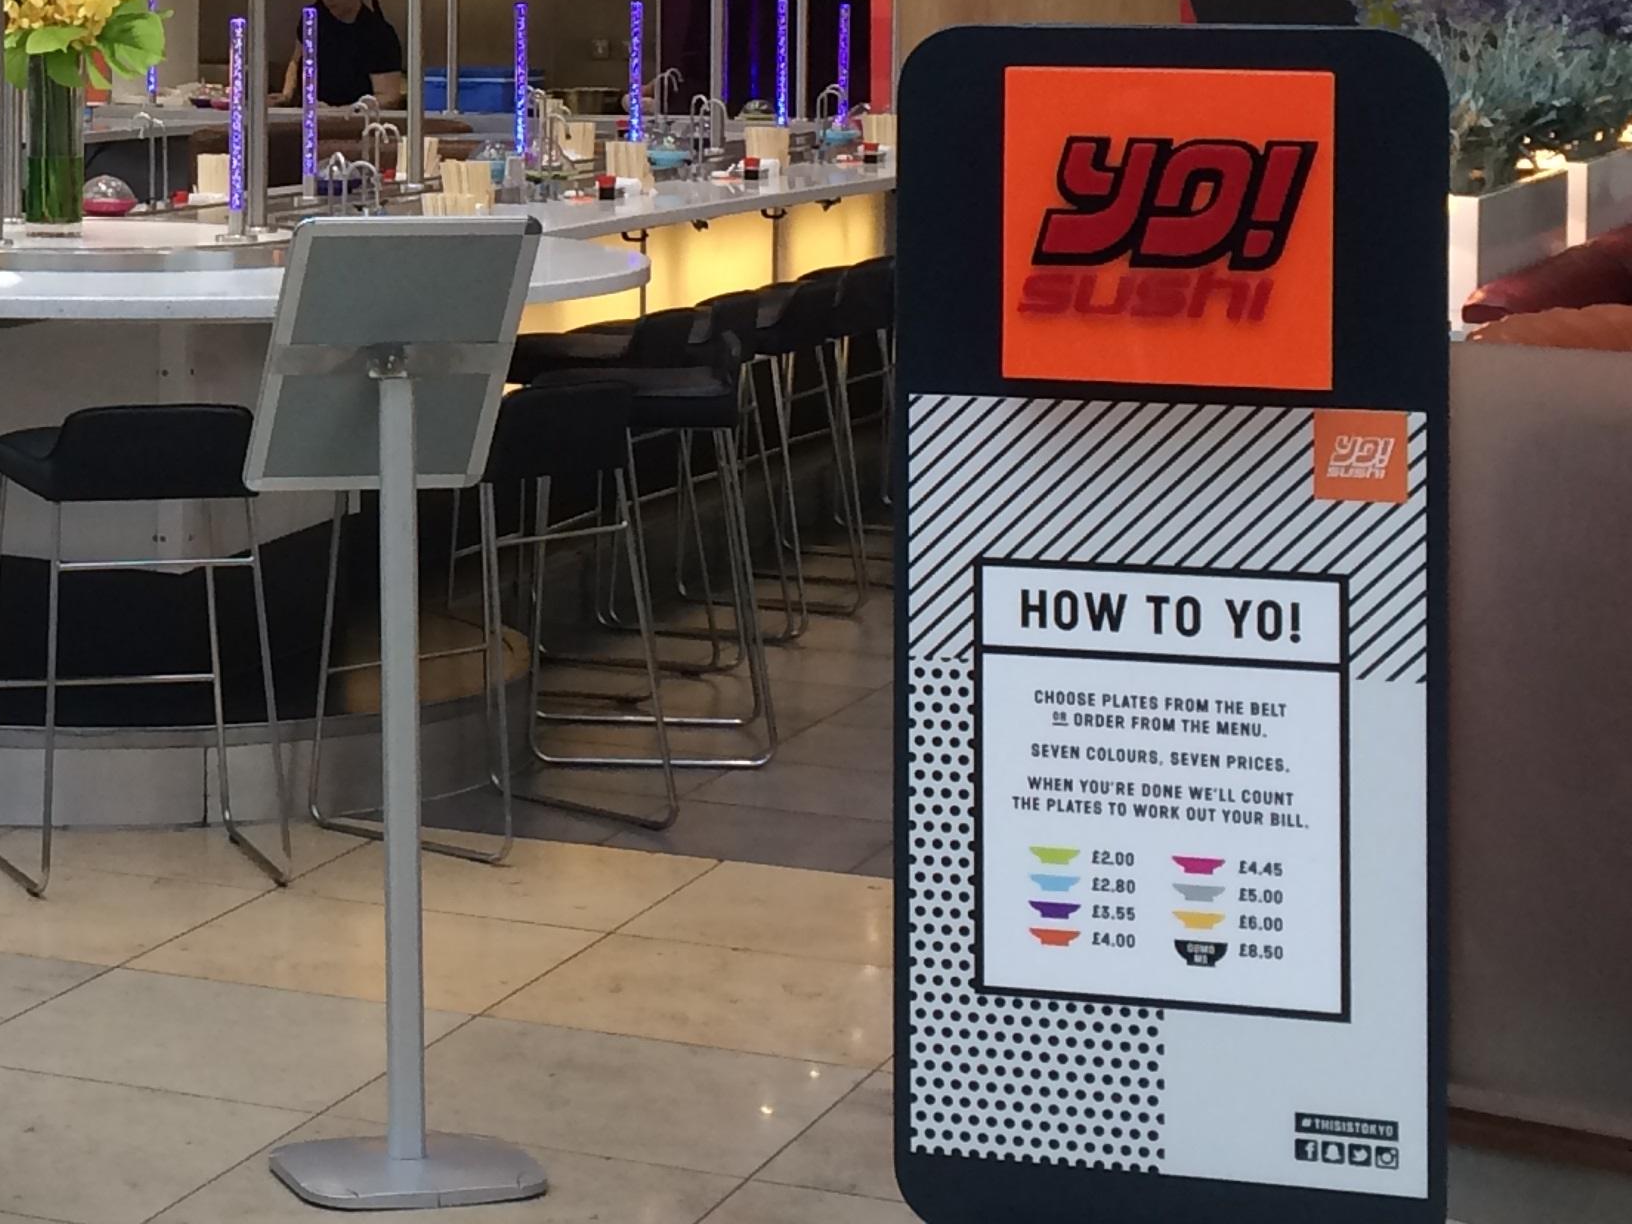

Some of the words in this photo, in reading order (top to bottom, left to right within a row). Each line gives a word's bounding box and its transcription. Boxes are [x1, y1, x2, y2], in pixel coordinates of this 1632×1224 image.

[1032, 135, 1319, 272] YO!
[1017, 267, 1275, 324] sushi
[1329, 435, 1395, 468] YO!
[1019, 589, 1128, 633] HOW
[1145, 595, 1202, 638] TO
[1225, 599, 1302, 644] YO!
[1034, 689, 1096, 707] CHOOSE
[1102, 693, 1159, 710] PLATES
[1165, 697, 1209, 713] FROM
[1215, 699, 1243, 715] THE
[1250, 701, 1287, 717] BELT
[1052, 711, 1069, 726] OR
[1074, 712, 1126, 729] ORDER
[1131, 716, 1176, 732] FROM
[1181, 719, 1209, 735] THE
[1216, 721, 1269, 738] MENU.
[1031, 743, 1080, 759] SEVEN
[1086, 746, 1164, 766] COLOURS,
[1170, 751, 1220, 768] SEVEN
[1226, 755, 1291, 773] PRICES.
[1027, 776, 1074, 792] WHEN
[1079, 779, 1135, 797] YOU'RE
[1141, 783, 1183, 799] DONE
[1188, 786, 1235, 803] WE'LL
[1241, 789, 1294, 806] COUNT
[1012, 795, 1041, 811] THE
[1046, 797, 1103, 815] PLATES
[1108, 801, 1127, 817] TO
[1133, 803, 1180, 820] WORK
[1186, 806, 1216, 822] OUT
[1221, 809, 1264, 825] YOUR
[1270, 812, 1310, 829] BILL.
[1091, 850, 1135, 866] £2.00
[1238, 860, 1283, 877] £4.45
[1091, 877, 1136, 894] £2.80
[1238, 887, 1283, 905] £5.00
[1091, 904, 1136, 921] £3.55
[1238, 914, 1283, 932] £6.00
[1091, 931, 1136, 949] £4.00
[1238, 942, 1283, 960] £8.50
[1301, 1118, 1394, 1138] #THISISTOKYO
